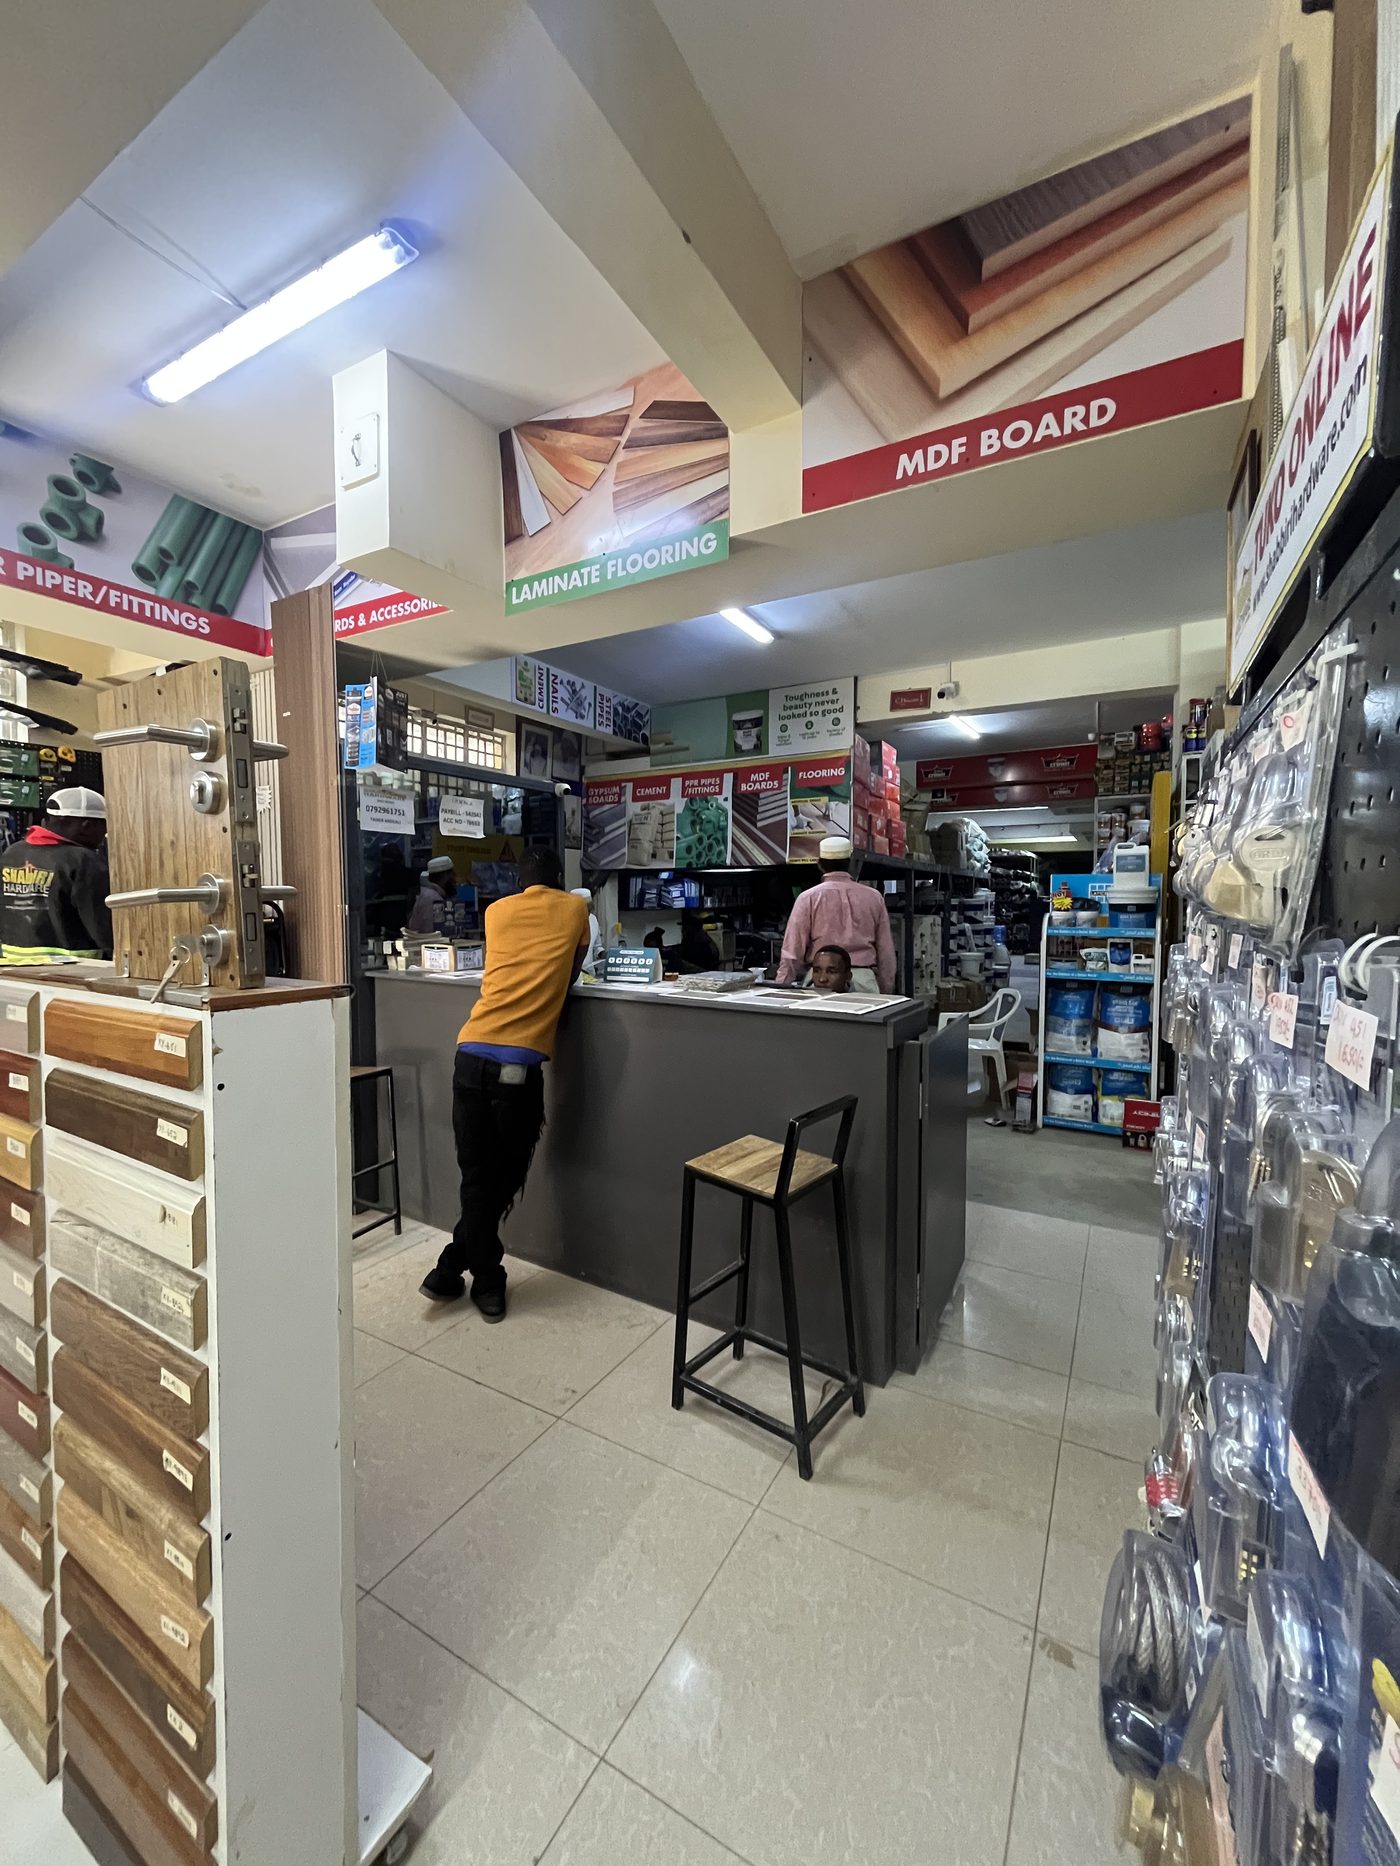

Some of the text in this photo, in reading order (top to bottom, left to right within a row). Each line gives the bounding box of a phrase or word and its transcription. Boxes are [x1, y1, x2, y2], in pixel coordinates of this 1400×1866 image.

[1254, 222, 1377, 575] TUKO ONLINE
[895, 397, 1117, 480] MDF BOARD
[511, 532, 718, 605] LAMINATE FLOORING
[16, 560, 211, 635] PIPER/FITTINGS
[335, 597, 443, 632] RDS & ACCESSORI
[537, 665, 545, 710] CEMENT
[551, 673, 559, 714] NAILS
[784, 687, 838, 702] Toughness &
[783, 698, 840, 712] beauty never
[778, 710, 808, 721] looked
[821, 705, 844, 717] good
[750, 772, 770, 782] MDF
[798, 767, 846, 779] FLOORING
[685, 777, 720, 787] PPR PIPES
[740, 780, 779, 791] BOARDS
[588, 785, 620, 796] GYPSUM
[636, 786, 667, 796] CEMENT
[684, 785, 720, 796] /FITTINGS
[588, 794, 619, 804] BOARDS
[440, 808, 461, 816] PAYBILL
